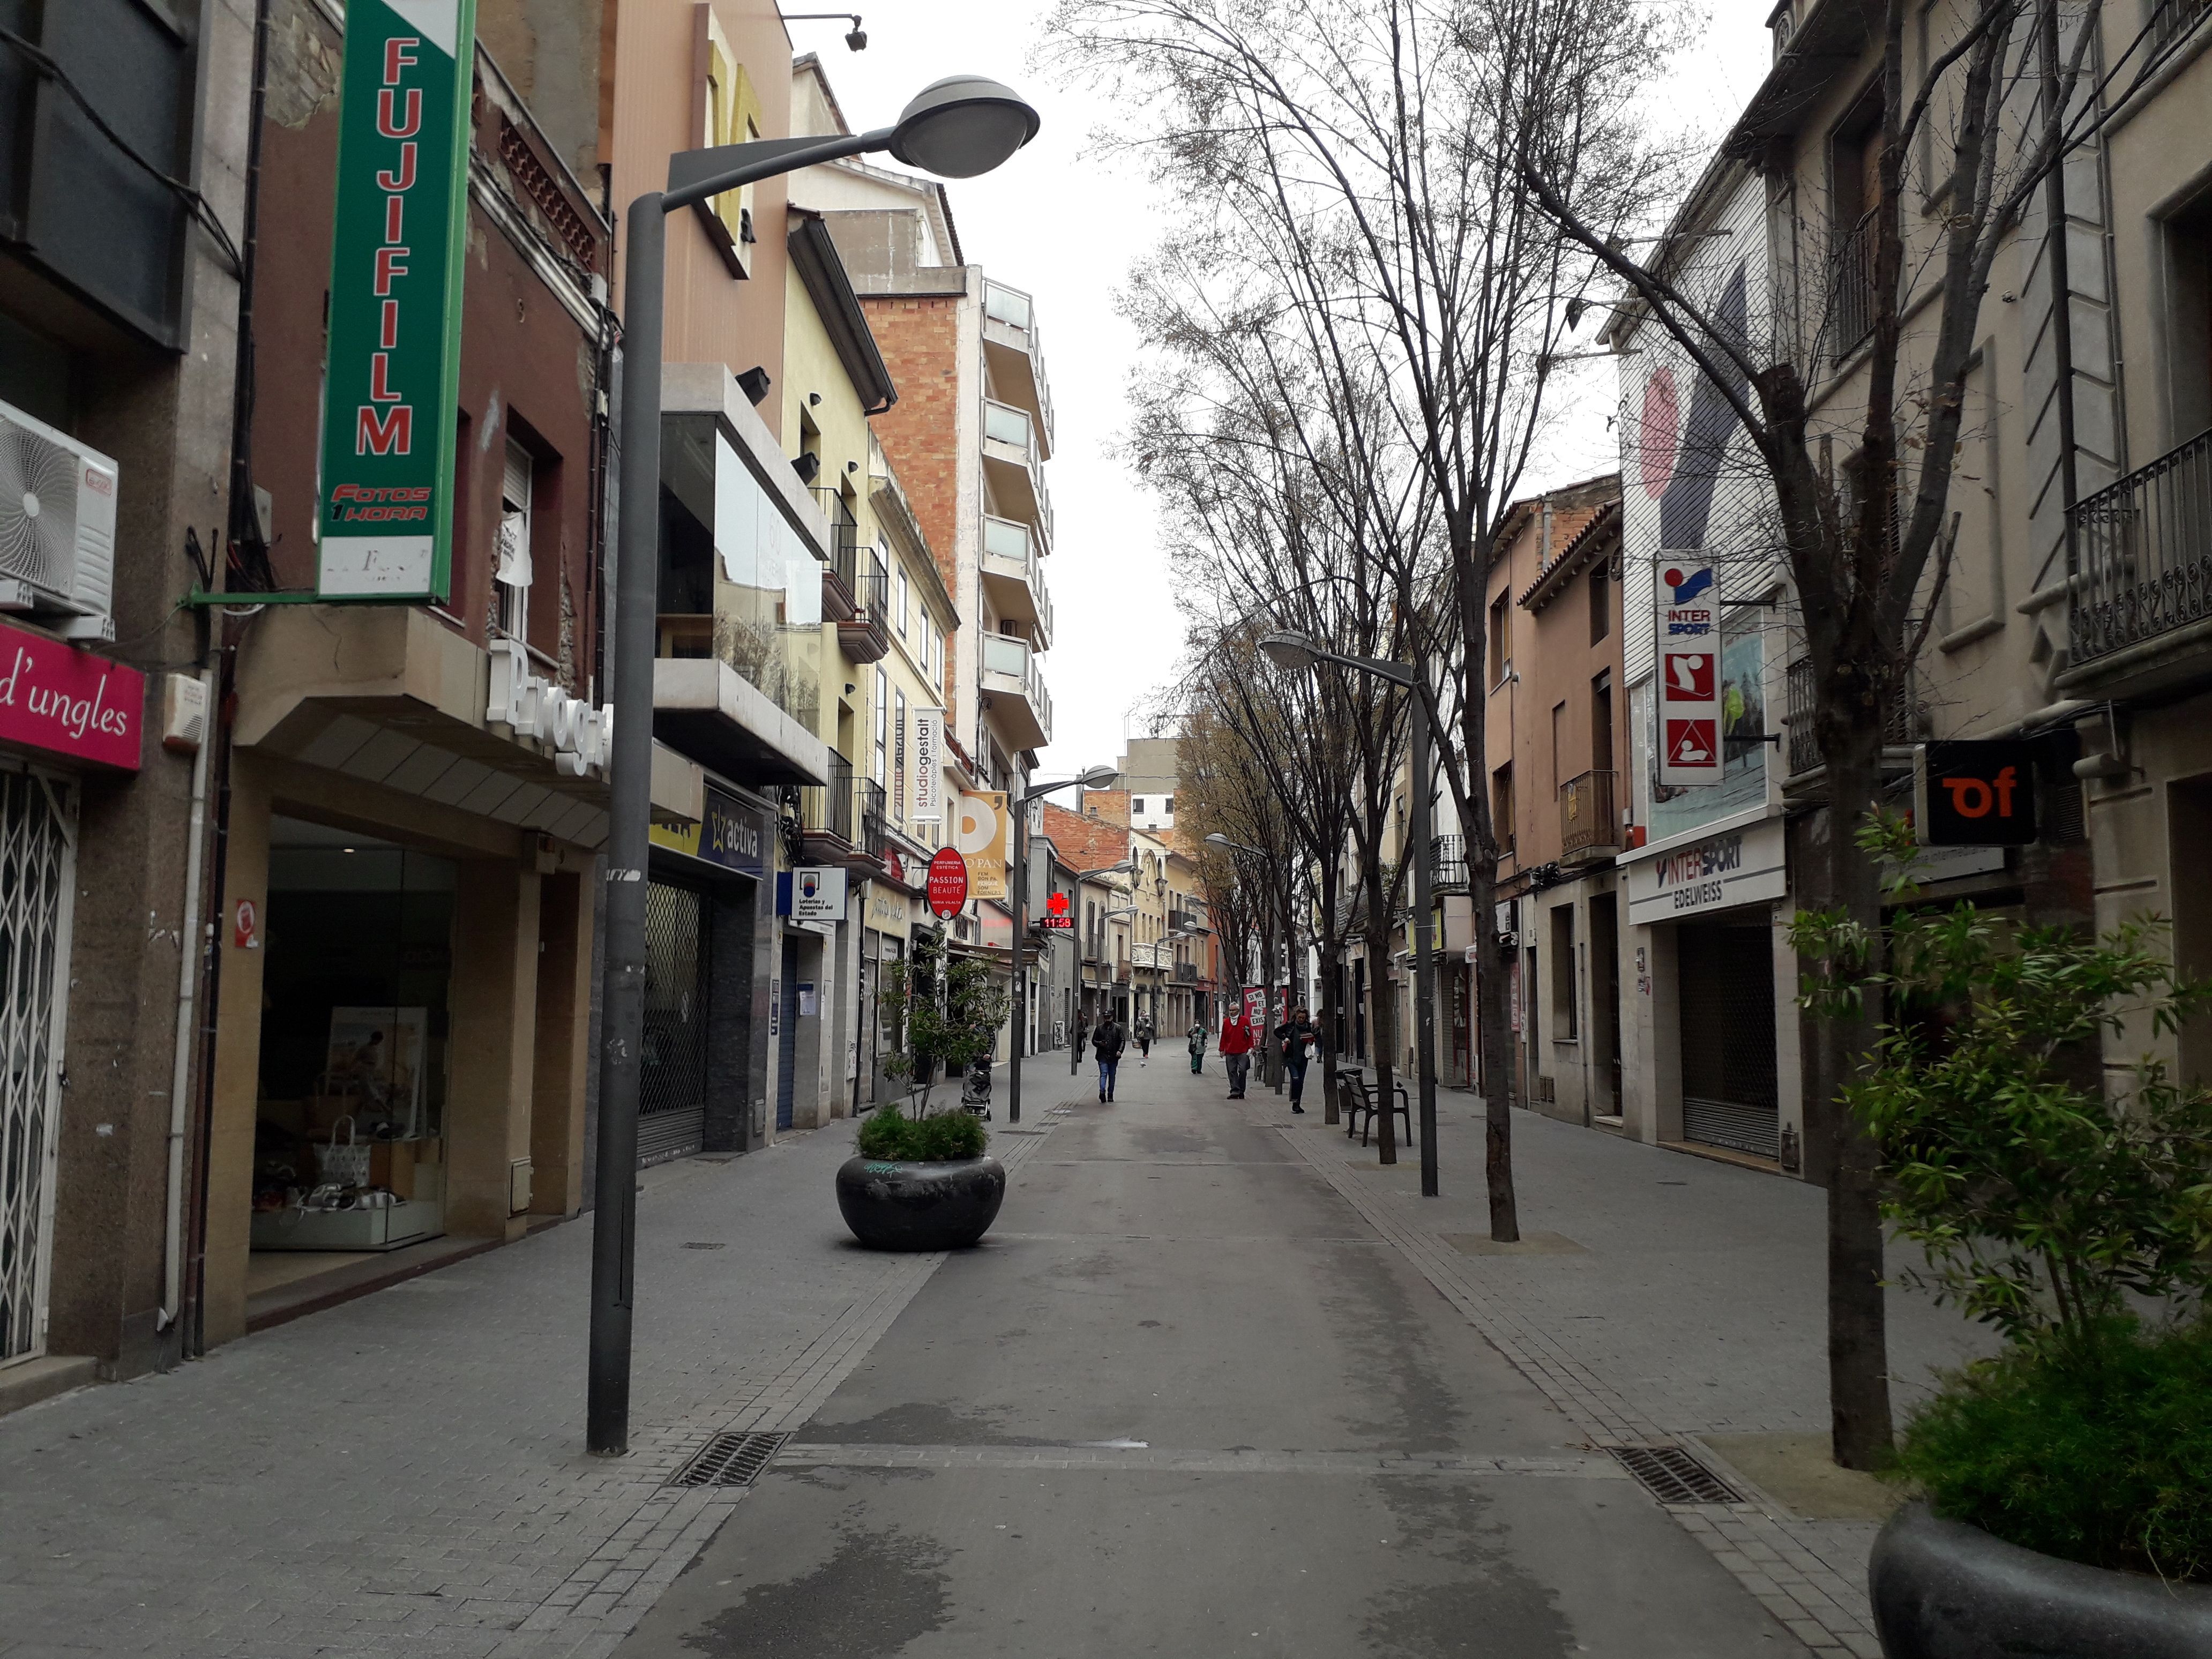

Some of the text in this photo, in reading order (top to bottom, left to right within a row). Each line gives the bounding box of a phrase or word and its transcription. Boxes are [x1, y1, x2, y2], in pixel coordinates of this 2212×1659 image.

[356, 37, 423, 455] FUJIFILM
[331, 503, 428, 521] 1 HORA
[1668, 610, 1710, 622] INTER
[1668, 623, 1710, 635] SPORT
[0, 646, 128, 739] d'ungles
[487, 638, 614, 776] Progr
[916, 718, 931, 808] studiogestalt
[1942, 766, 2017, 818] of
[727, 816, 758, 858] activa
[965, 858, 1003, 868] O'PAN
[1668, 835, 1742, 885] INTERSPORT
[933, 884, 963, 894] BEAUTÉ
[1674, 879, 1723, 909] EDELWEISS
[1044, 918, 1071, 928] 11:58
